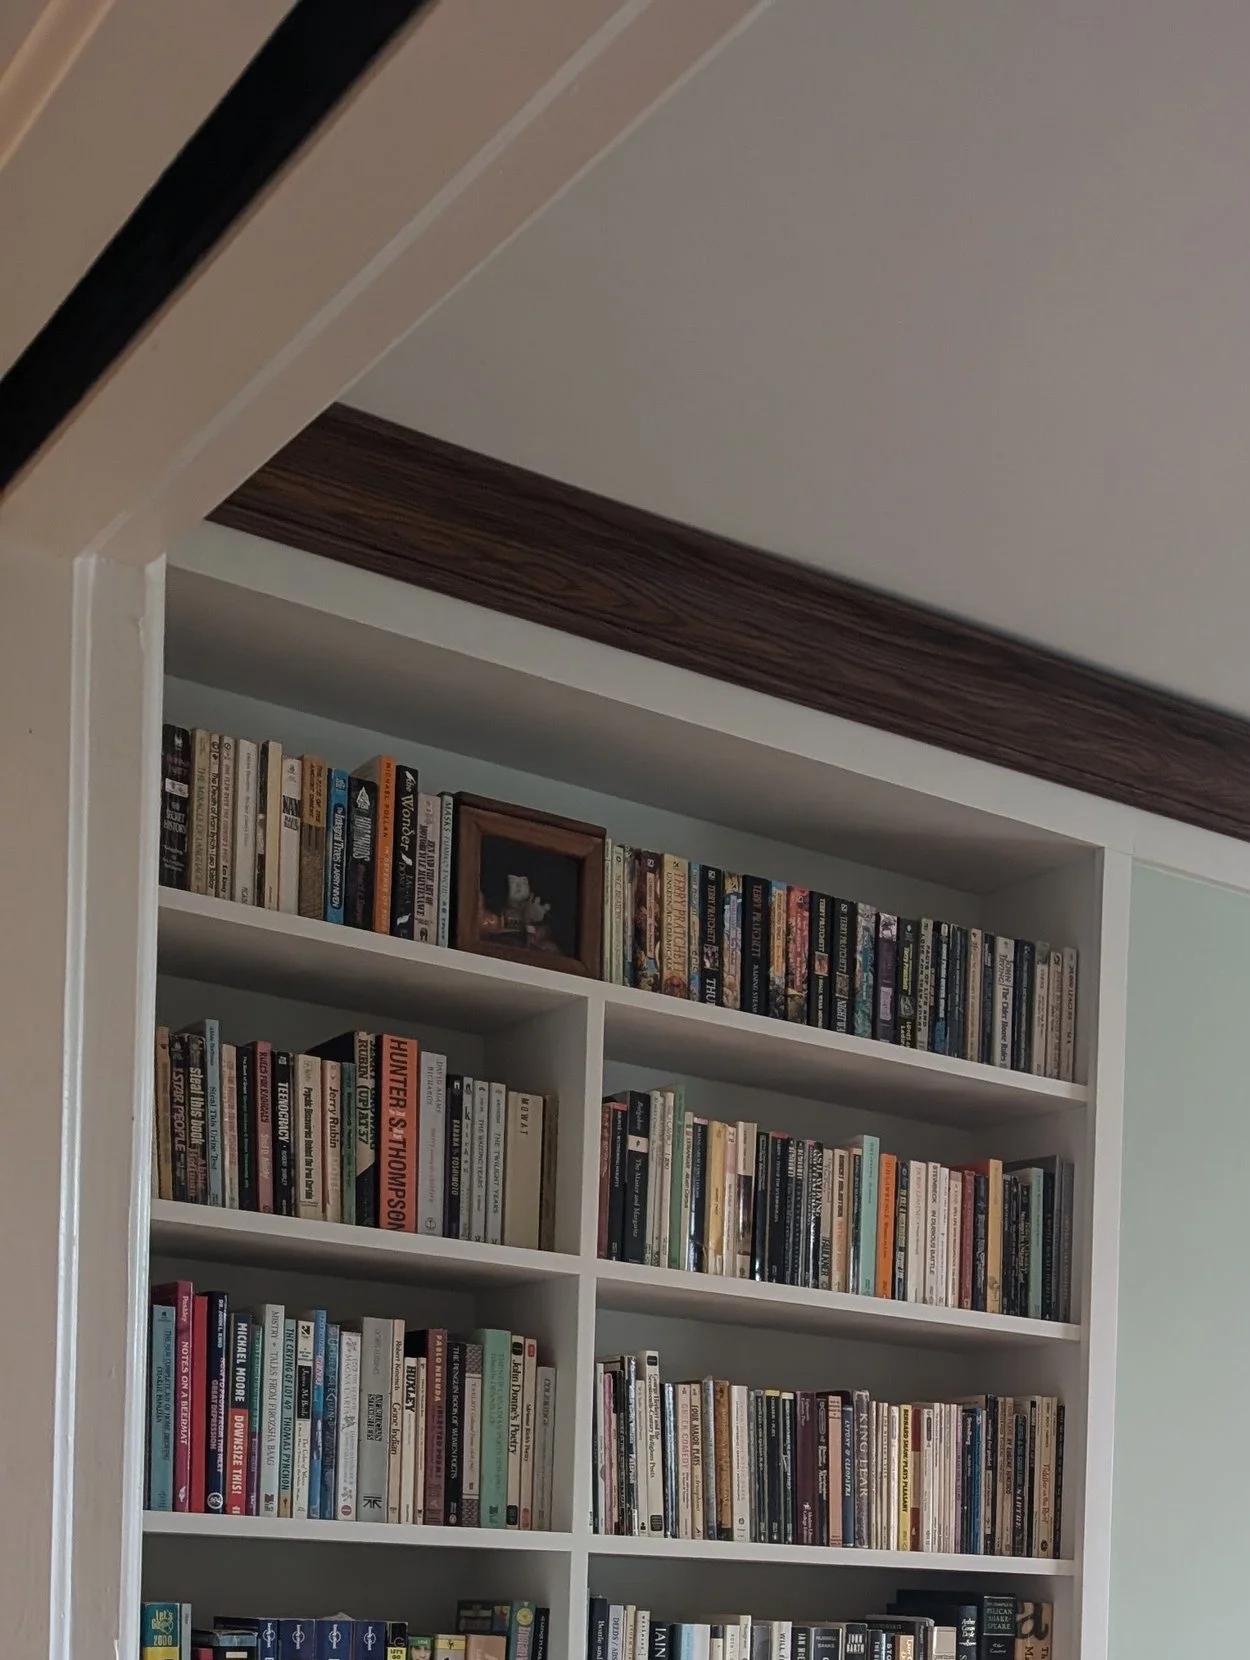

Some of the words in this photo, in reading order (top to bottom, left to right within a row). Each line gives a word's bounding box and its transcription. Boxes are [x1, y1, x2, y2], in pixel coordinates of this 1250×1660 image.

[443, 801, 452, 832] MASKS
[331, 864, 341, 886] LARRY
[674, 873, 685, 904] TERRY
[331, 886, 340, 907] NIVEN
[673, 908, 685, 975] PRATCHETT
[839, 936, 847, 973] PRATCHETT
[190, 1067, 203, 1094] steal
[389, 1038, 407, 1109] HUNTER
[191, 1097, 204, 1118] this
[209, 1087, 217, 1106] Steal
[329, 1086, 338, 1115] Jerry
[278, 1082, 288, 1143] TEENOCRACY
[520, 1098, 529, 1135] MOWAT
[191, 1119, 205, 1145] book
[329, 1117, 338, 1148] Rubin
[387, 1139, 406, 1231] THOMPSON
[821, 1239, 830, 1276] FAULKNER
[270, 1311, 279, 1338] MISTRY
[286, 1329, 294, 1342] THE
[181, 1342, 189, 1373] NOTES
[236, 1323, 247, 1363] MICHAEL
[285, 1344, 294, 1372] CRYING
[269, 1352, 278, 1376] TALES
[284, 1374, 293, 1384] OF
[511, 1359, 521, 1382] John
[181, 1376, 188, 1389] ON
[235, 1368, 246, 1401] MOORE
[268, 1378, 277, 1400] FROM
[284, 1386, 292, 1399] LOT
[405, 1366, 417, 1412] HUXLEY
[283, 1400, 292, 1410] 49
[392, 1402, 401, 1427] Gone
[511, 1384, 520, 1420] Donne's
[180, 1401, 188, 1444] BEERMAT
[268, 1404, 277, 1442] FIROZSHA
[283, 1417, 292, 1450] THOMAS
[452, 1416, 458, 1425] OF
[860, 1413, 868, 1452] KING
[232, 1415, 244, 1466] DOWNSIZE
[391, 1428, 400, 1455] Indian
[509, 1424, 519, 1455] Poetry
[681, 1433, 689, 1468] COMEDY
[266, 1445, 276, 1466] BAAG
[232, 1469, 242, 1494] THIS!
[281, 1454, 290, 1490] PYNCHON
[860, 1460, 868, 1497] LEAR
[655, 1628, 666, 1658] IAIN
[797, 1633, 805, 1644] IAN
